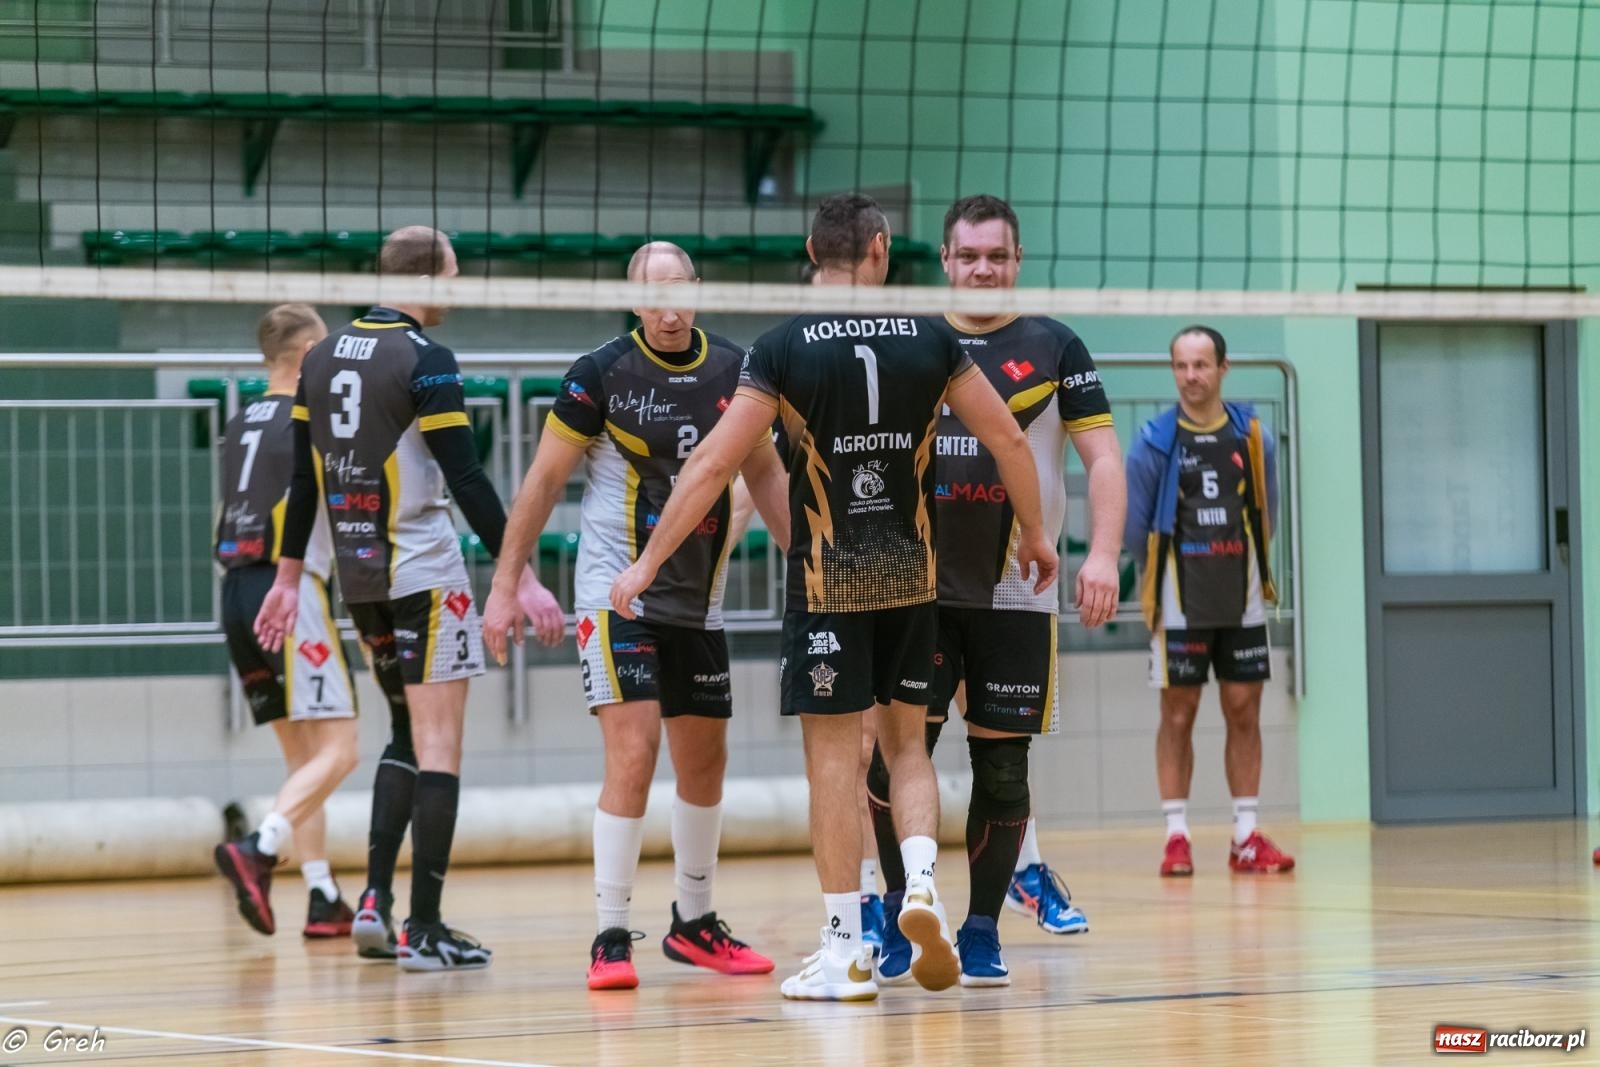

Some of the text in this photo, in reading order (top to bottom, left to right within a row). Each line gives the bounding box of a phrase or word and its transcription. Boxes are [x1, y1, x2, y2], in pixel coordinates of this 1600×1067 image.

[803, 318, 918, 343] KOŁODZIEJ
[333, 335, 378, 360] ENTER
[854, 345, 879, 424] 1
[1063, 371, 1099, 389] GRAV
[330, 369, 362, 439] 3
[634, 388, 677, 425] Hair
[677, 425, 698, 459] 2
[833, 432, 912, 454] AGROTIM
[936, 436, 978, 456] ENTER
[935, 481, 1006, 503] ALMAG
[1202, 470, 1219, 499] 5
[456, 630, 468, 661] 3
[808, 632, 828, 640] DARK
[808, 647, 829, 655] CARS
[309, 676, 323, 703] 7
[900, 678, 928, 690] AGROTIM
[986, 682, 1040, 694] GRAVTON
[984, 702, 1018, 715] GTrans
